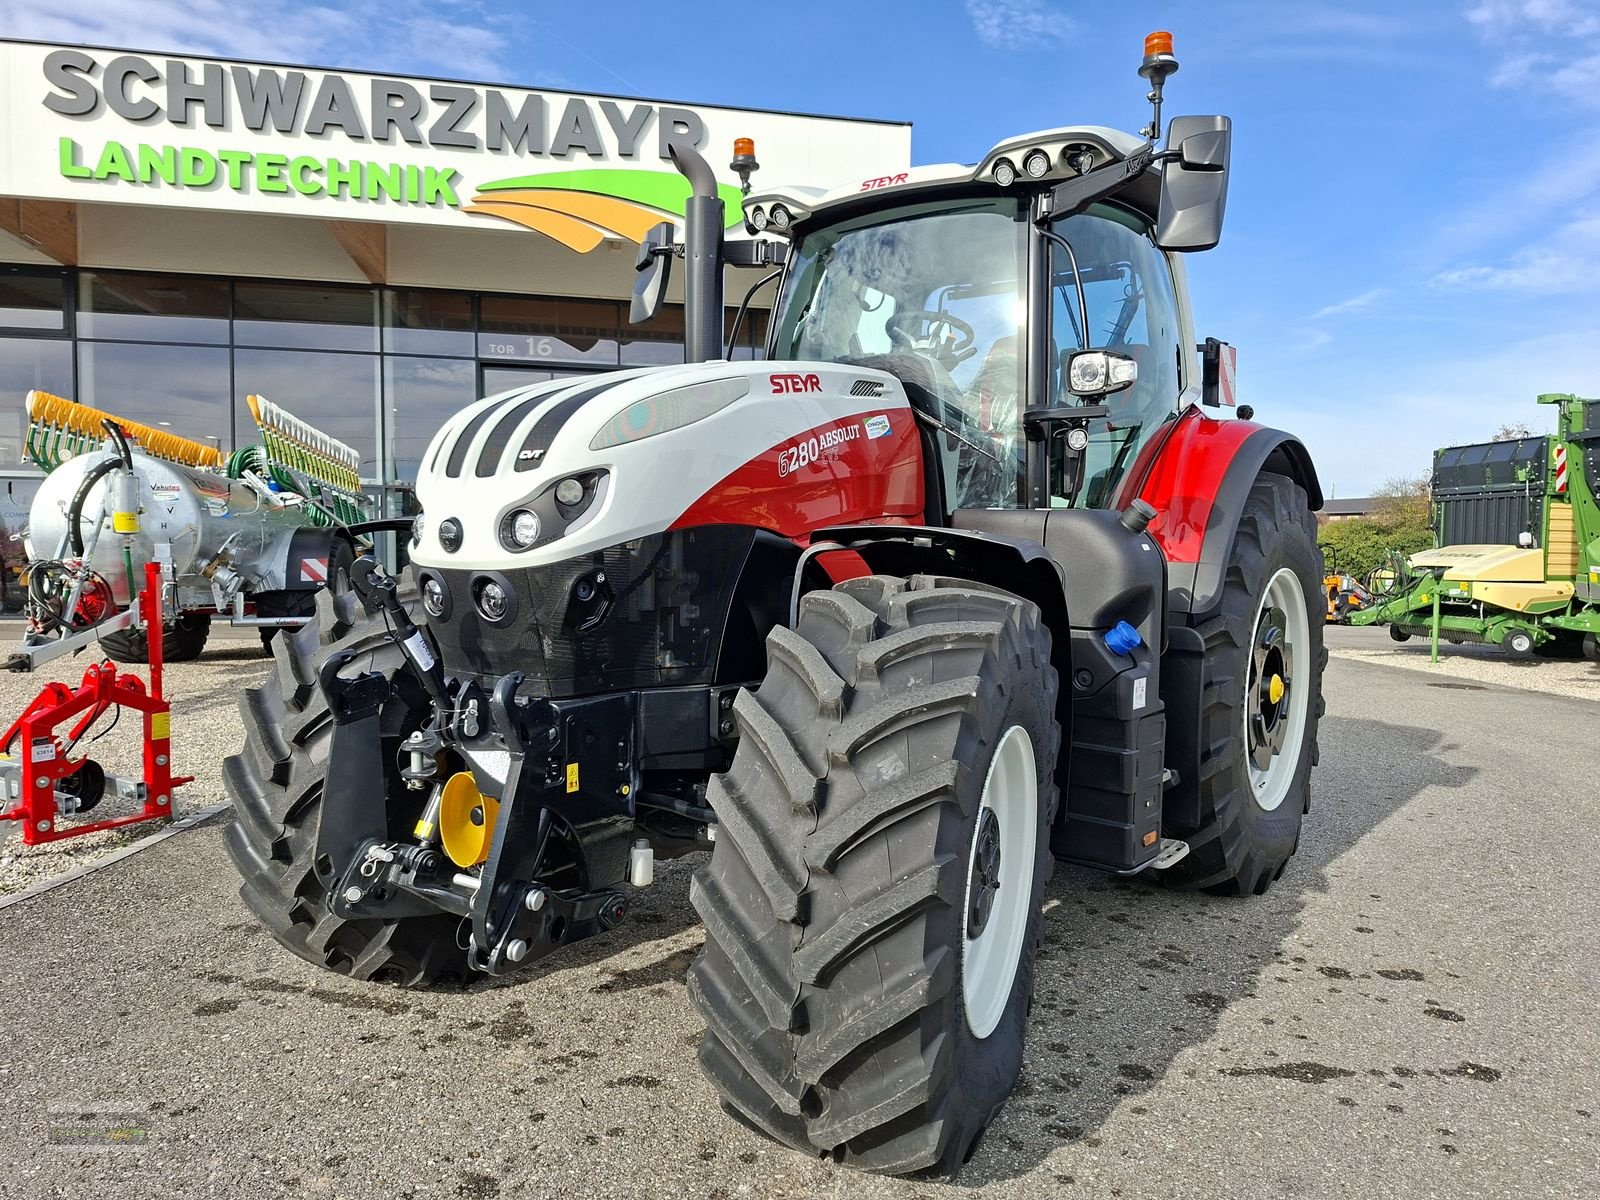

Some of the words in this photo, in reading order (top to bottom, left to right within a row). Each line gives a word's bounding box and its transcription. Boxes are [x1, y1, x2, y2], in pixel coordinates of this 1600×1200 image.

[42, 49, 704, 160] SCHWARZMAYR
[59, 136, 459, 206] LANDTECHNIK
[859, 173, 909, 192] STEYR
[489, 343, 515, 355] TOR
[526, 337, 553, 356] 16
[769, 373, 823, 394] STEYR
[518, 449, 545, 460] CVT
[778, 437, 820, 478] 6280
[819, 424, 861, 451] ABSOLUT
